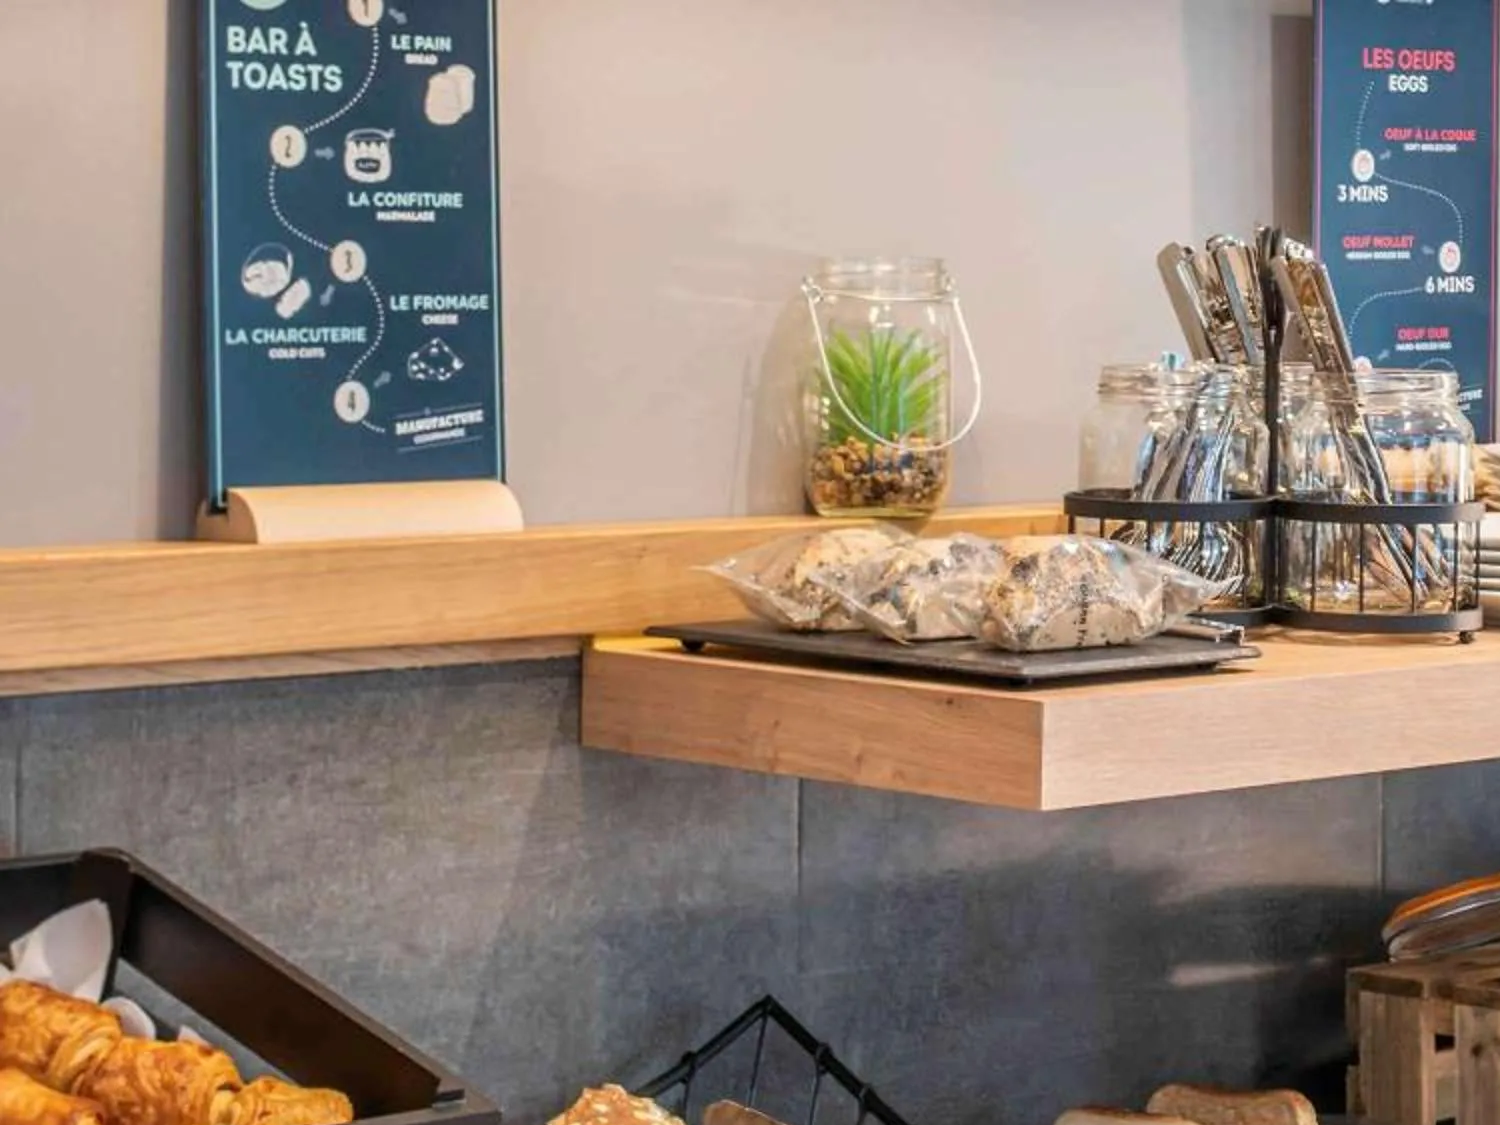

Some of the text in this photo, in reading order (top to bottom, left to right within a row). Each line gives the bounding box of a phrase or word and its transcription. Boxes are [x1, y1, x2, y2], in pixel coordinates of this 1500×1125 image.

[227, 21, 317, 56] BAR À
[391, 34, 451, 52] LE PAIN
[1363, 47, 1455, 72] LES OEUFS
[225, 60, 343, 93] TOASTS
[1388, 74, 1428, 93] EGGS
[1384, 127, 1413, 140] OEUF
[1425, 129, 1439, 141] LA
[1440, 129, 1477, 141] COQUE
[347, 192, 463, 208] LA CONFITURE
[1337, 184, 1389, 203] 3 MINS
[1343, 235, 1414, 249] OEUF MOLLET
[1424, 275, 1475, 294] 6 MINS
[390, 294, 489, 311] LE FROMAGE
[225, 326, 367, 345] LA CHARCUTERIE
